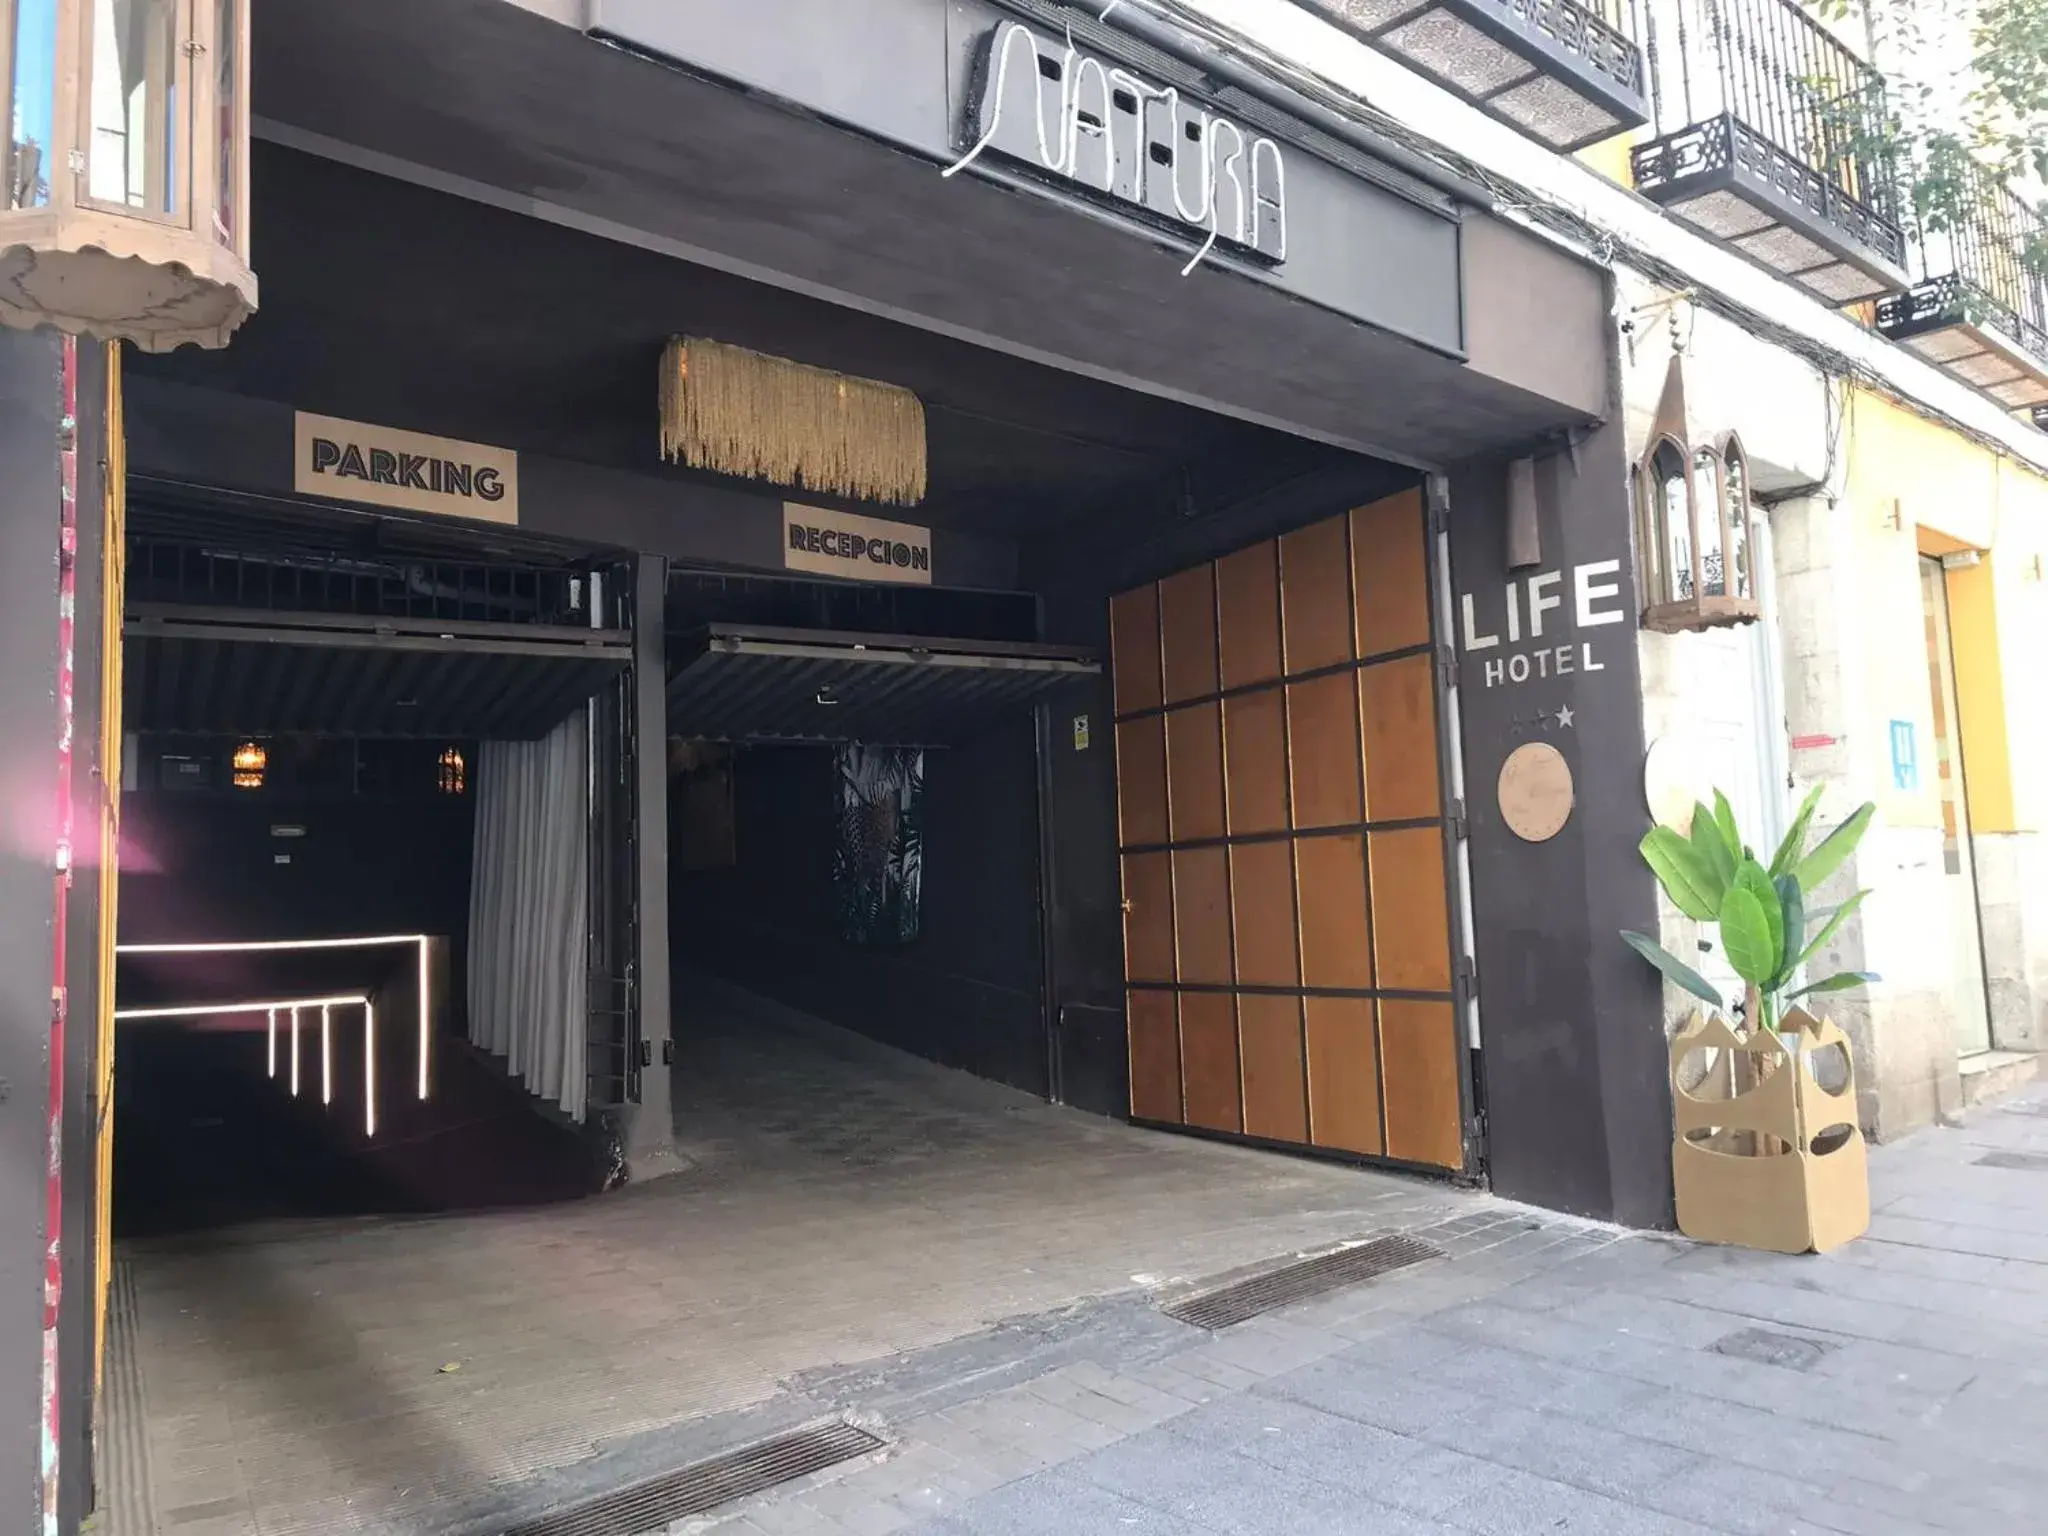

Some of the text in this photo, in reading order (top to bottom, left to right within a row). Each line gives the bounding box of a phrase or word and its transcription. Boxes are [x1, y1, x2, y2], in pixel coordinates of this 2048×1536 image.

[941, 24, 1287, 276] NATURA
[312, 437, 505, 501] PARKING
[789, 523, 929, 571] RECEPCION
[1462, 559, 1624, 651] LIFE
[1485, 643, 1605, 688] HOTEL
